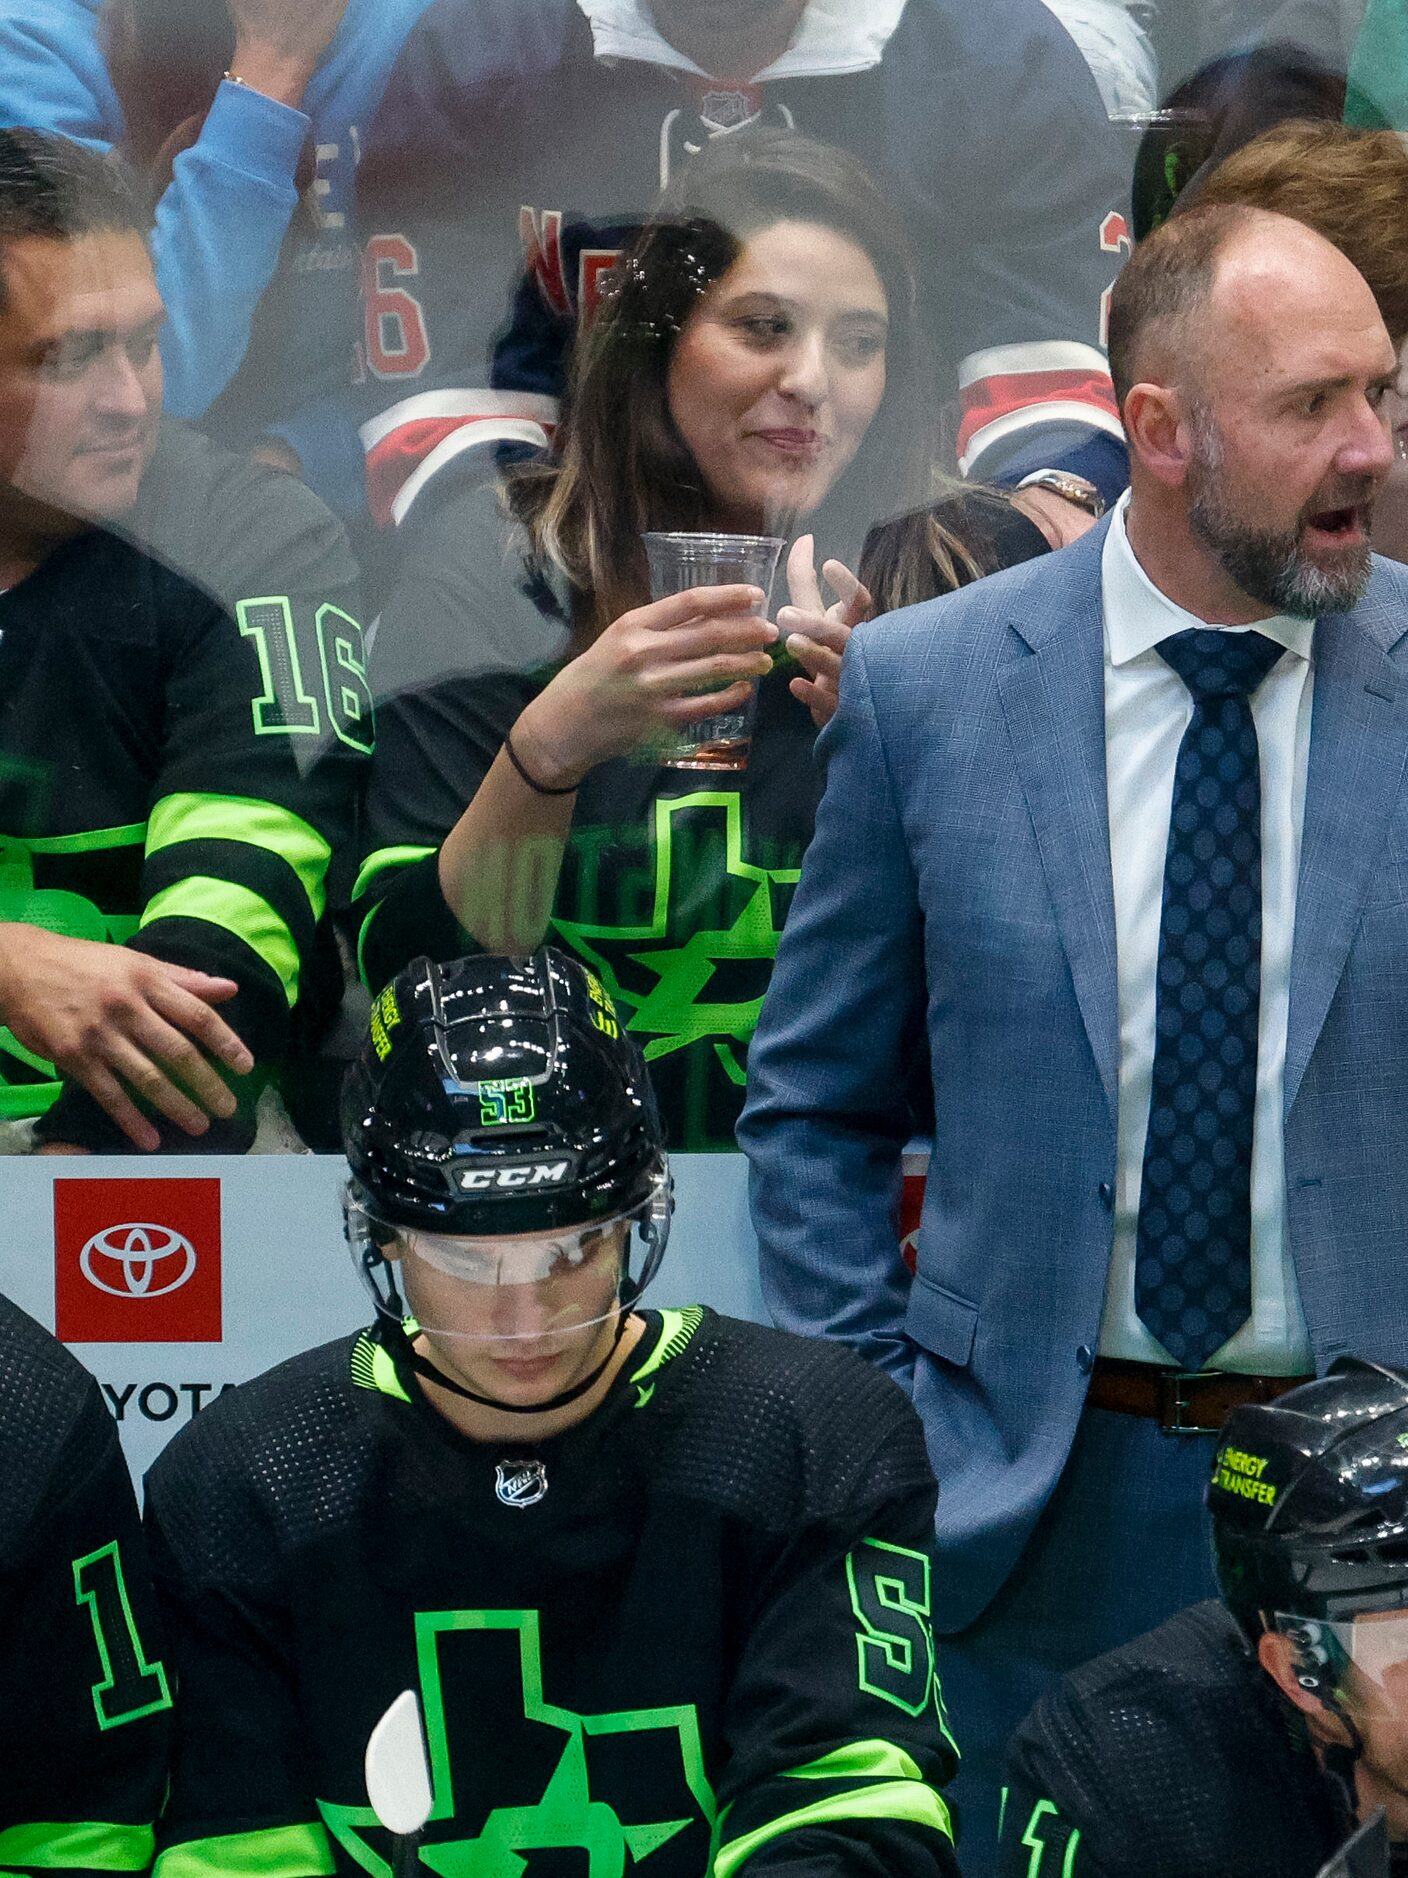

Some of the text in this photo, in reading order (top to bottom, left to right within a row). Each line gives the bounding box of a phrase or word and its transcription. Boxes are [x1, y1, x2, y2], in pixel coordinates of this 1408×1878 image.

[351, 233, 431, 383] 6
[235, 595, 376, 755] 16
[459, 1160, 568, 1189] CCM
[478, 1076, 535, 1127] 53
[72, 1540, 173, 1731] 1
[845, 1537, 962, 1759] 5
